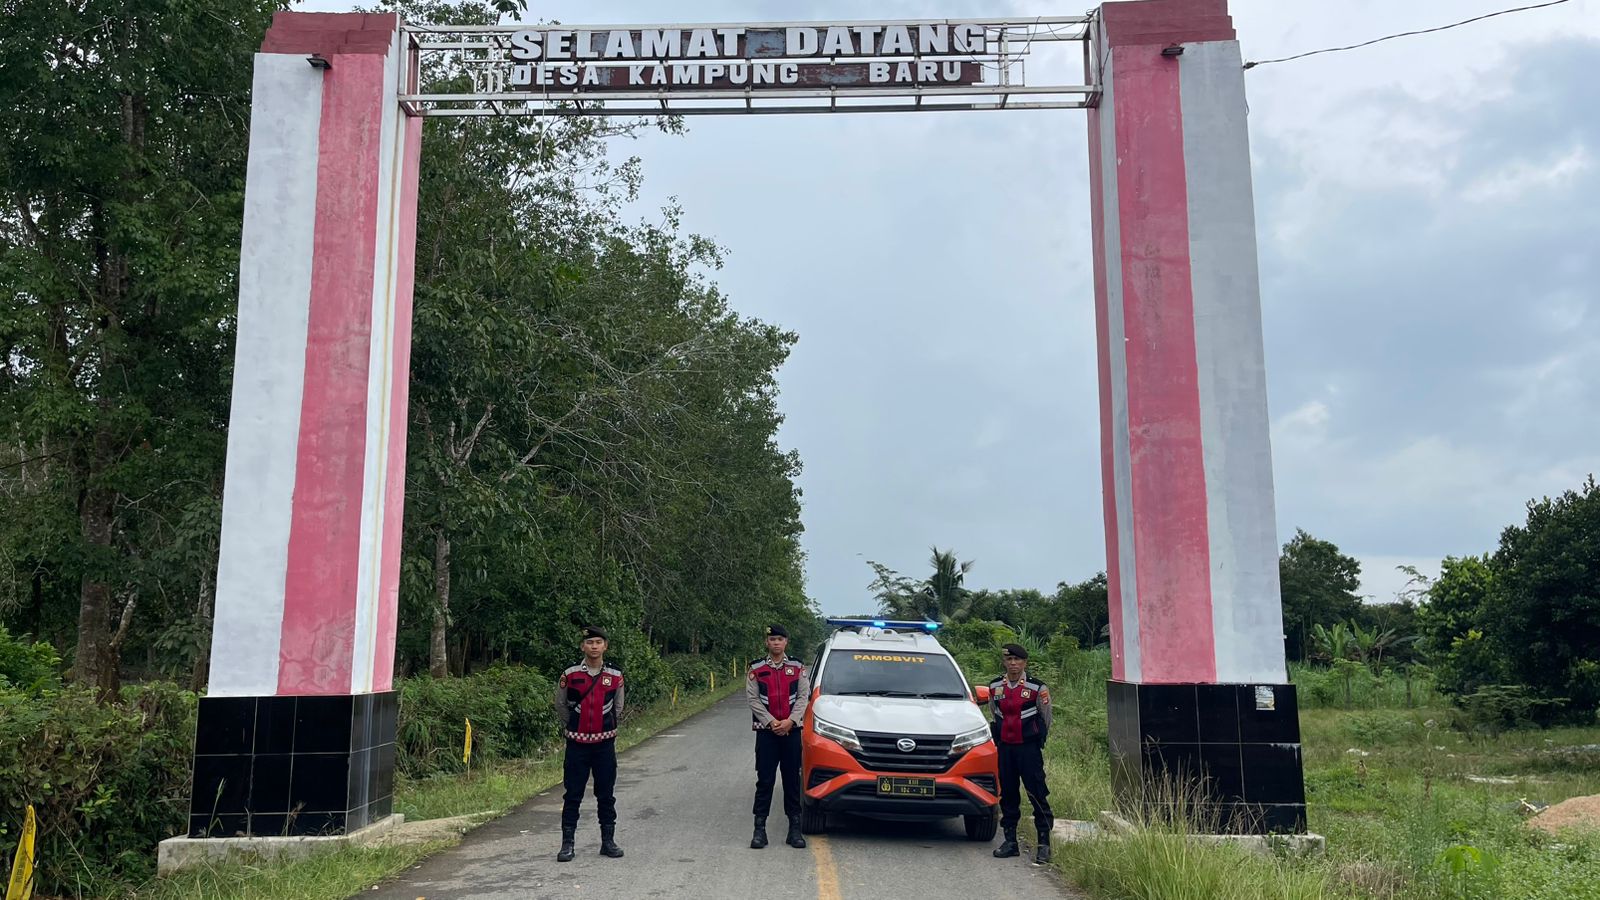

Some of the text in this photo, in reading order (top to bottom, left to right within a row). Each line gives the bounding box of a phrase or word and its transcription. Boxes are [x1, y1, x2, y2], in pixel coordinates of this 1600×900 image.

[510, 24, 986, 60] SELAMAT DATANG
[512, 61, 963, 86] DESA KAMPUNG BARU
[853, 654, 926, 663] PAMOBVIT
